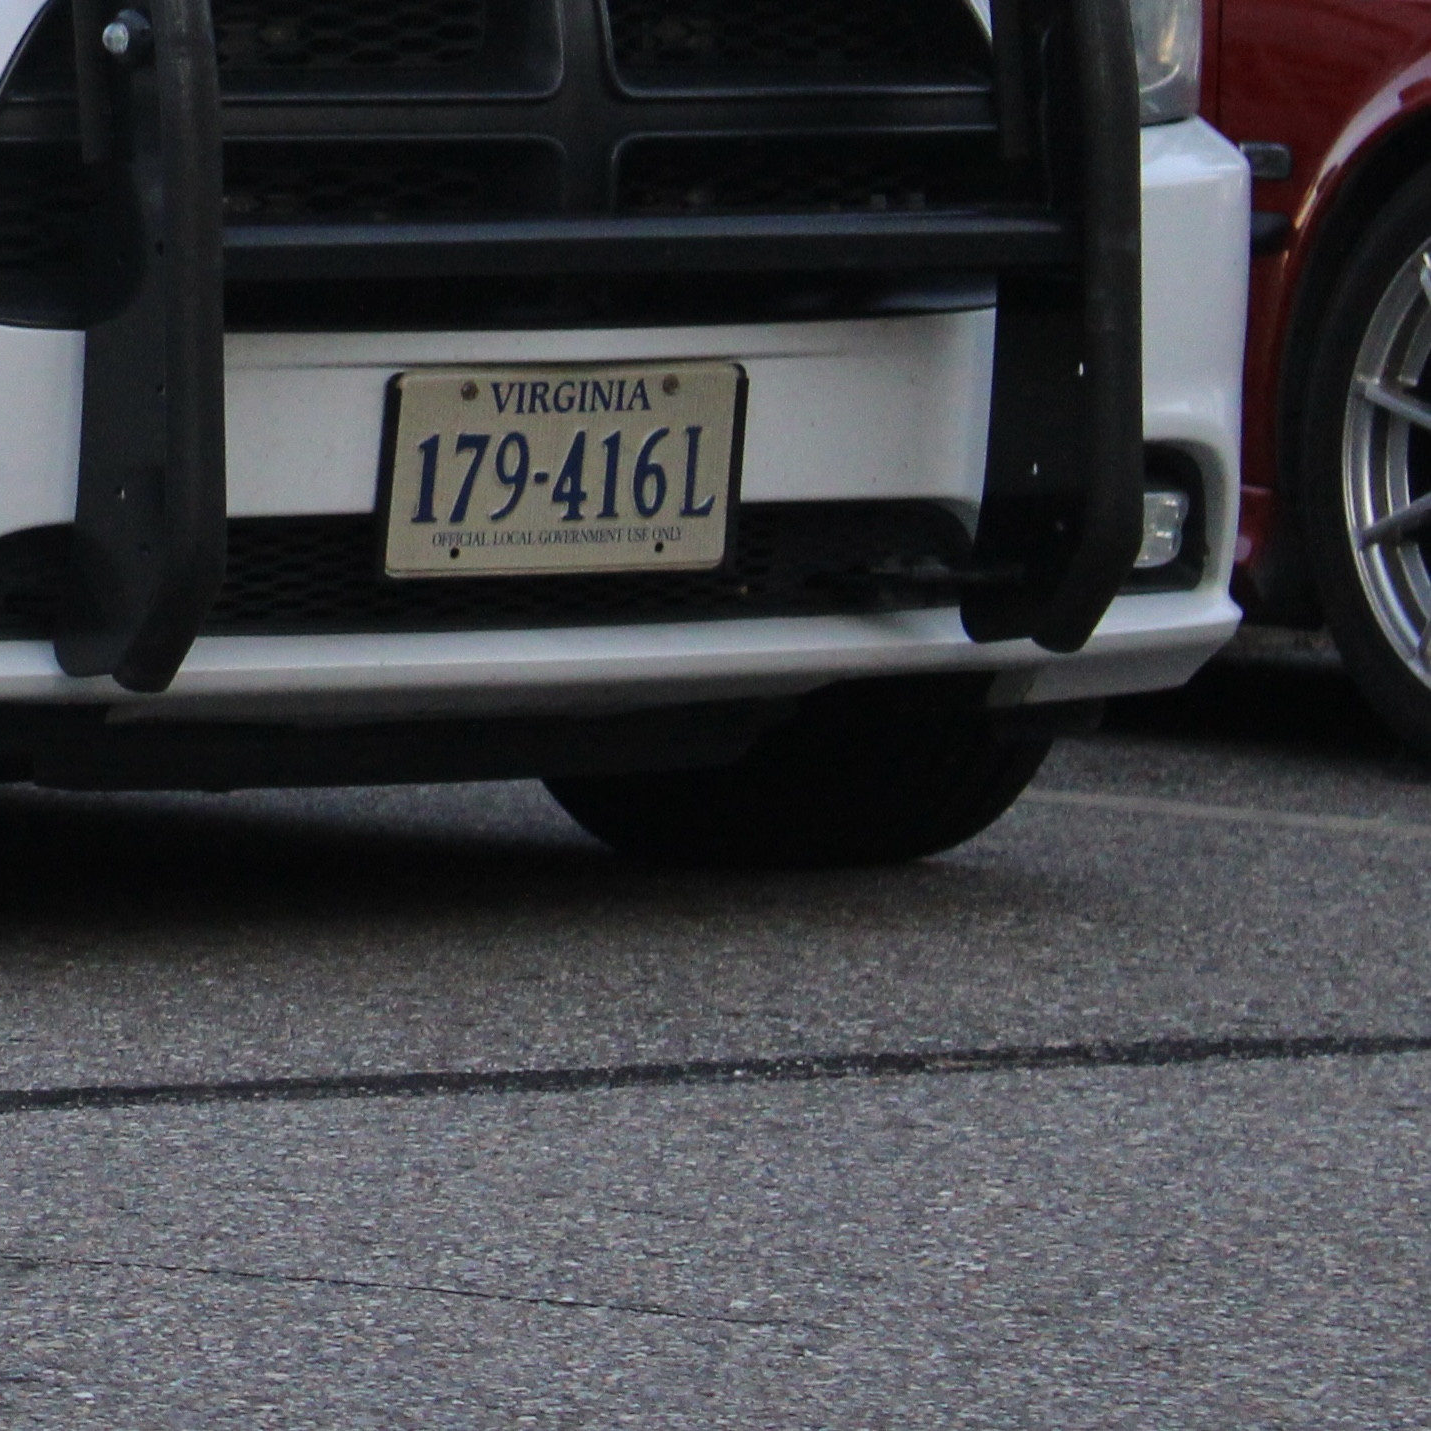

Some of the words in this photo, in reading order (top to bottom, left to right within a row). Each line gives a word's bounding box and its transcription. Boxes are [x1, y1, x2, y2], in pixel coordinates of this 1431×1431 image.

[491, 378, 651, 414] VIRGINIA
[410, 425, 716, 524] 179-416L
[432, 531, 487, 547] OFFICIAL
[493, 530, 535, 546] LOCAL
[539, 528, 623, 544] GOVERNMENT
[627, 527, 651, 542] USE
[652, 526, 683, 541] ONLY
